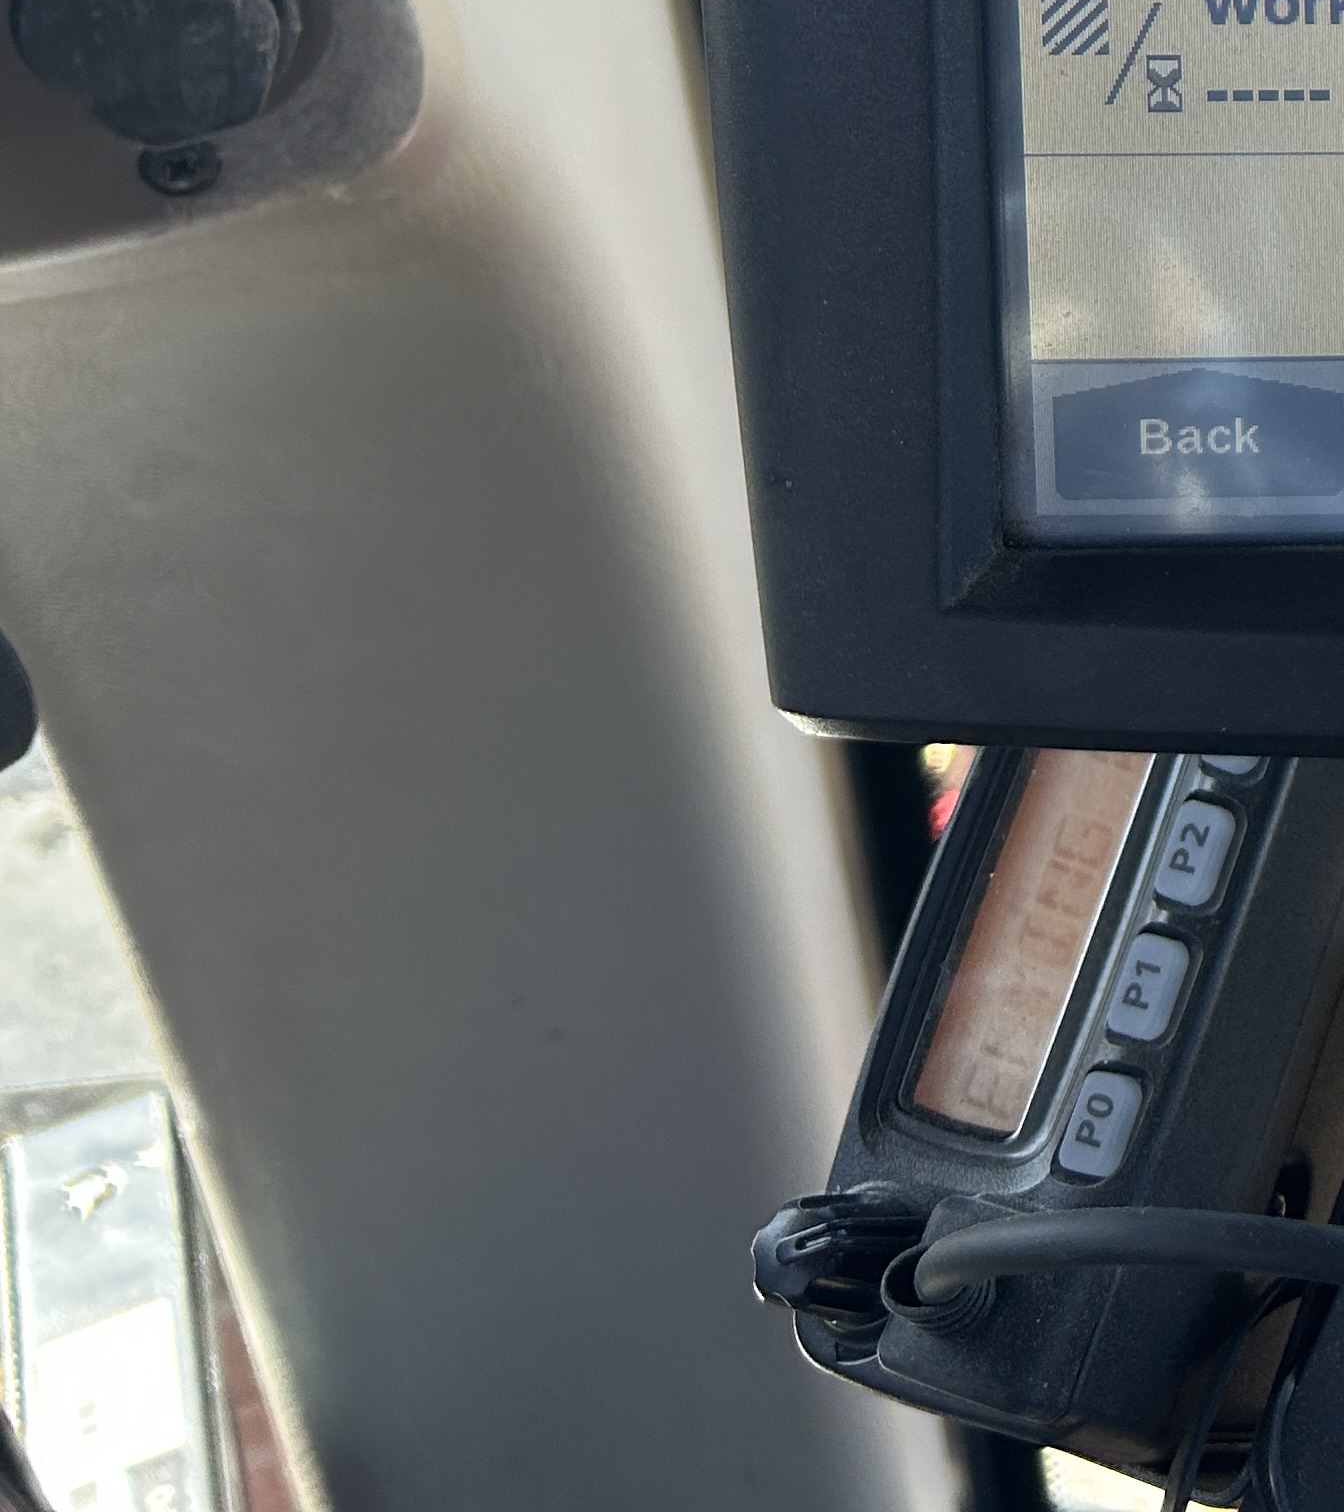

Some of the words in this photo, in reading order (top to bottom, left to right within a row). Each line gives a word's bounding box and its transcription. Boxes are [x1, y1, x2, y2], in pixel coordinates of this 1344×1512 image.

[1138, 416, 1262, 457] Back
[1169, 821, 1210, 875] P2
[1122, 958, 1162, 1011] P1
[1074, 1091, 1115, 1149] P0
